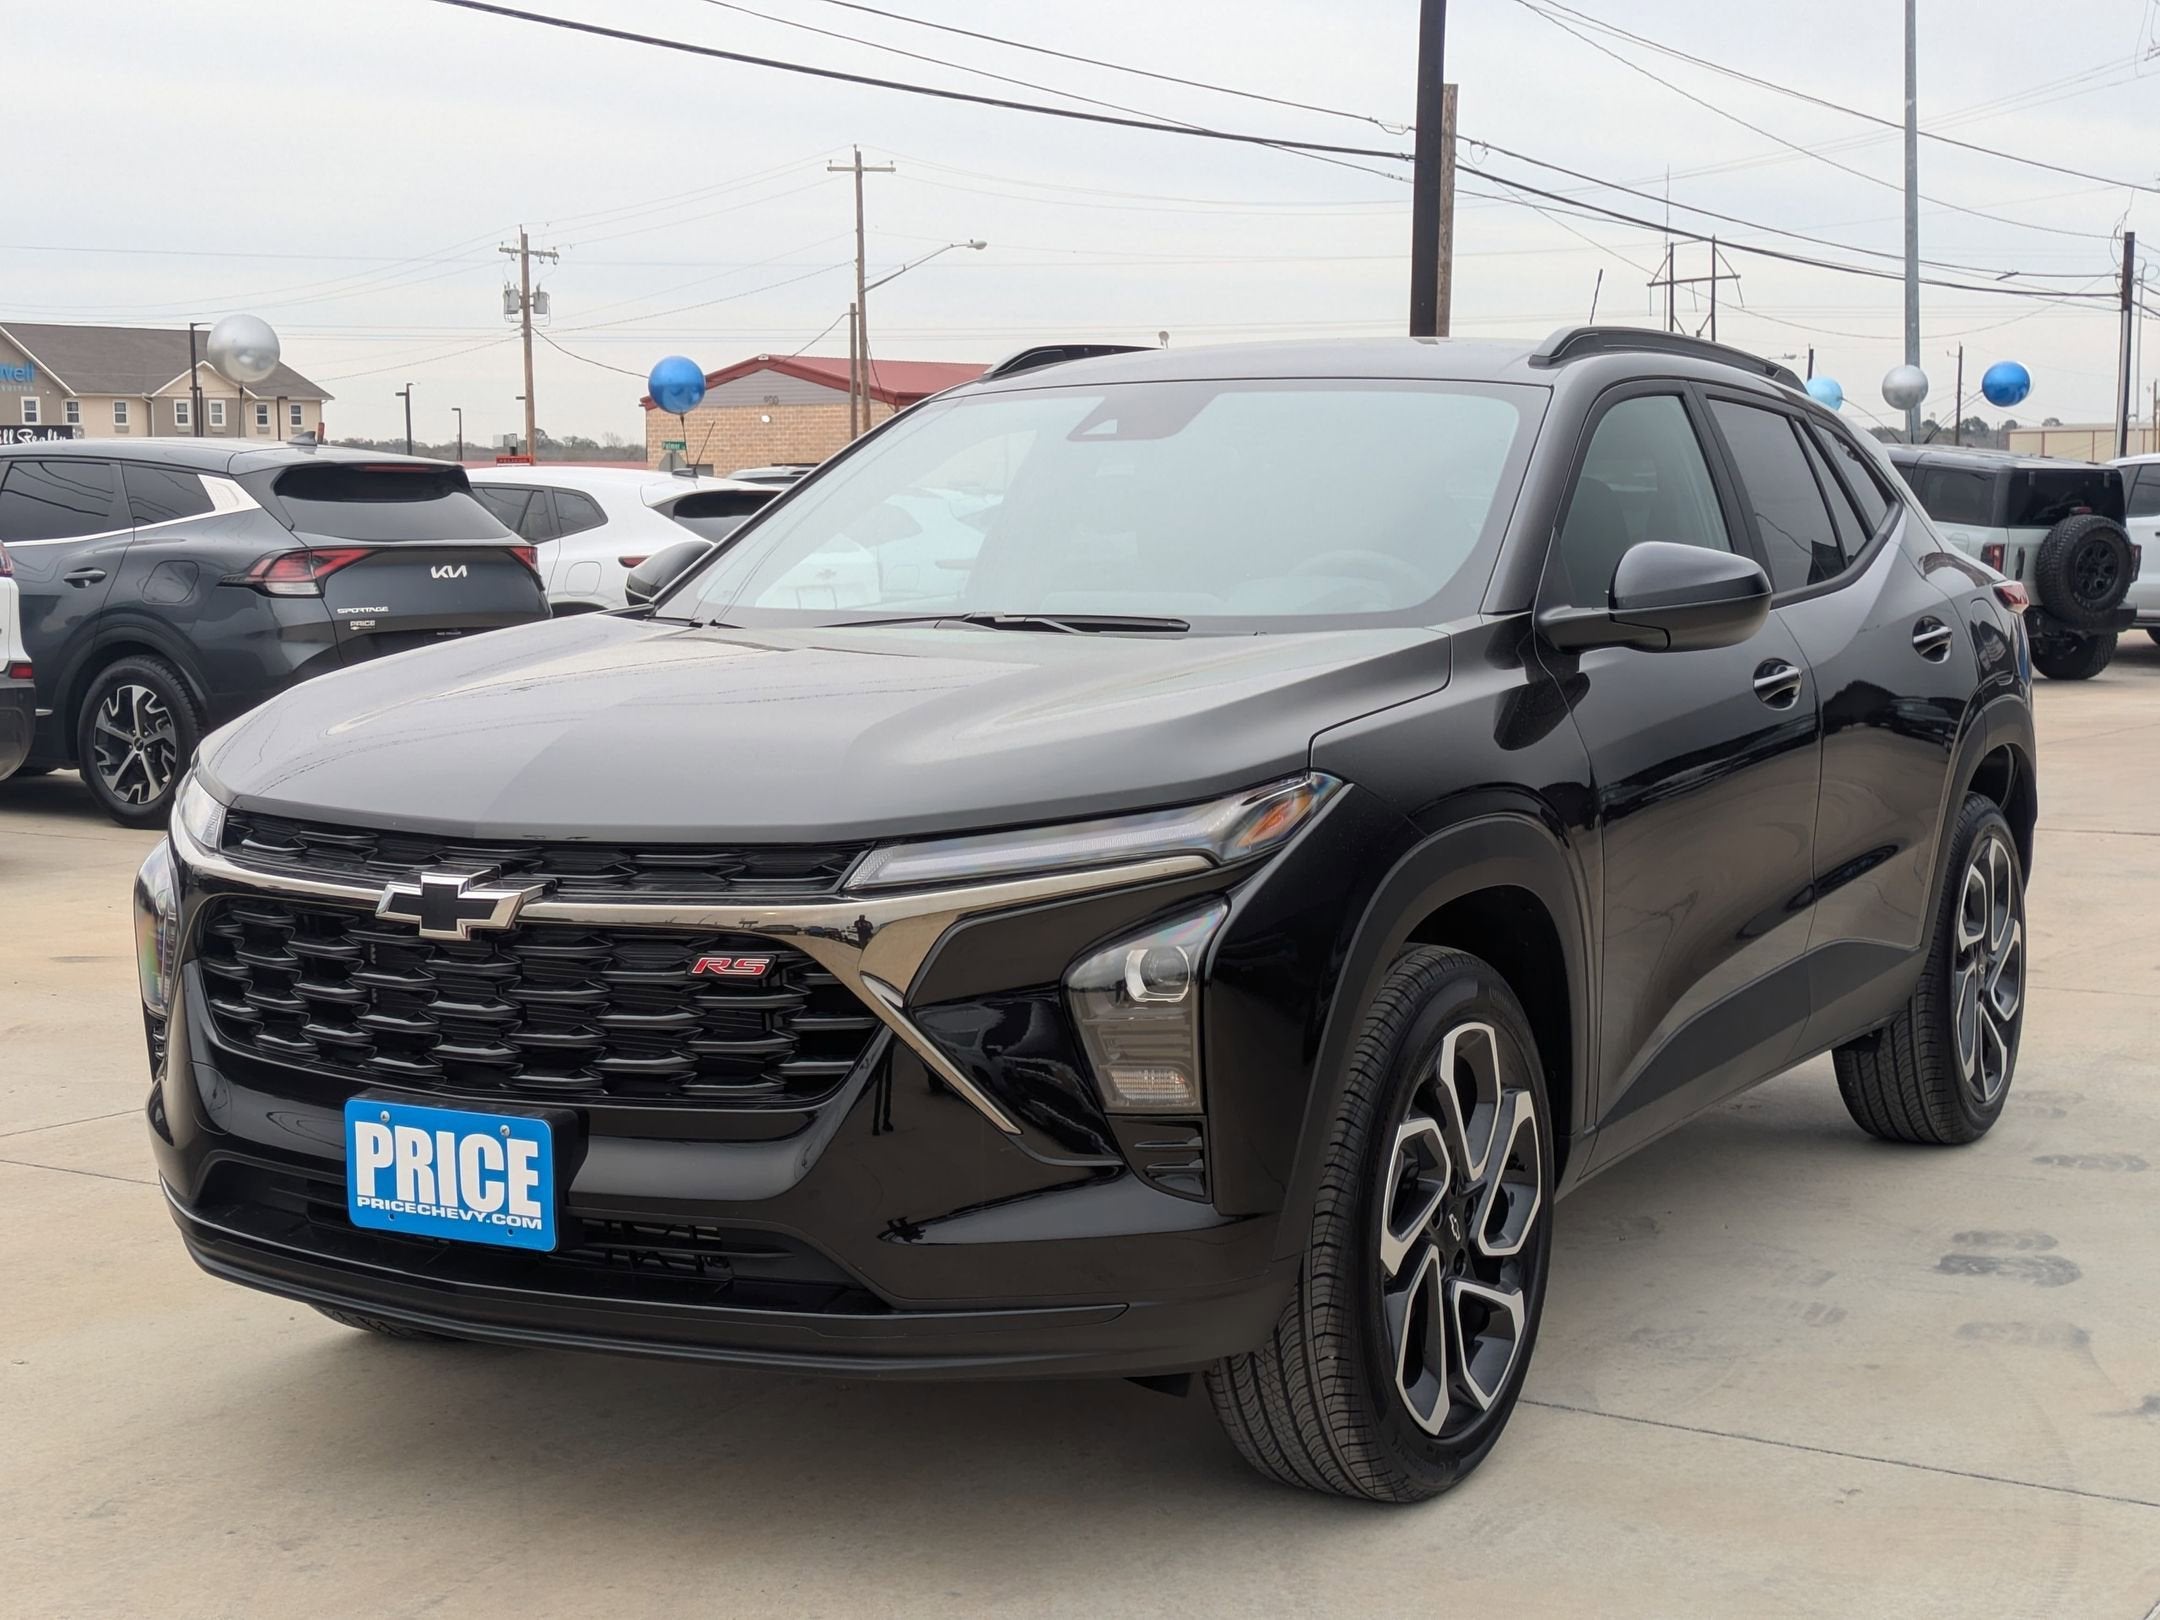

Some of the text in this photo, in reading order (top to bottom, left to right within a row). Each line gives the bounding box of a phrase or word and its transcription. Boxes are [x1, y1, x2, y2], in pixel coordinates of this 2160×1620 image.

[337, 606, 389, 614] SPORTAGE
[691, 957, 770, 976] RS
[354, 1120, 542, 1218] PRICE
[356, 1196, 543, 1231] PRICECHEVY.COM
